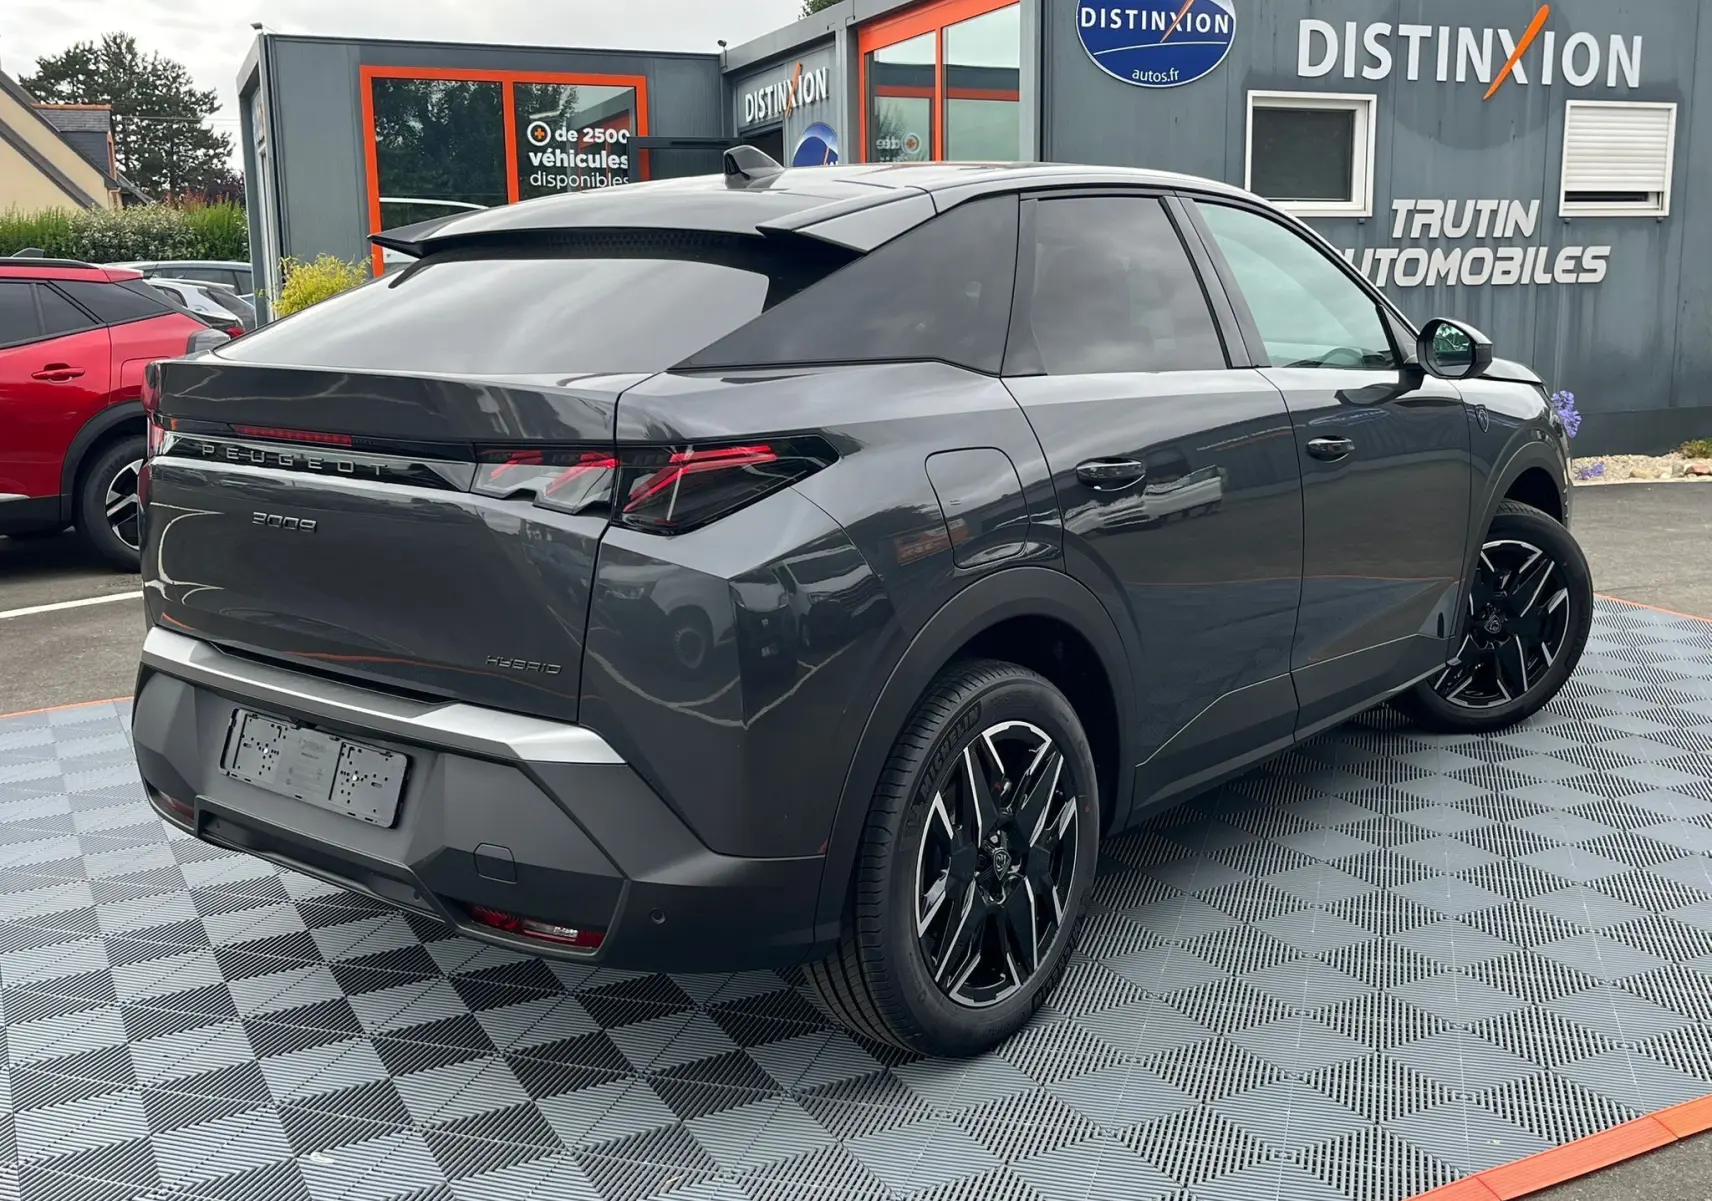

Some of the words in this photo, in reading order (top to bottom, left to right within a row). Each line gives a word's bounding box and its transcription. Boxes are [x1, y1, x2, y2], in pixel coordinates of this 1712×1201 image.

[1081, 0, 1229, 42] DISTINXION
[1297, 4, 1643, 100] DISTINXION
[745, 62, 827, 122] DISTINXION
[1132, 67, 1179, 82] autos.fr
[554, 127, 578, 142] de
[582, 128, 630, 144] 2500
[528, 148, 629, 169] véhicules
[530, 170, 629, 189] disponibles
[1391, 199, 1540, 238] TRUTIN
[1338, 246, 1612, 287] UTOMOBILES
[202, 444, 388, 475] PEUGEOT
[485, 655, 562, 674] HYBRID
[919, 705, 980, 800] MICHELIN
